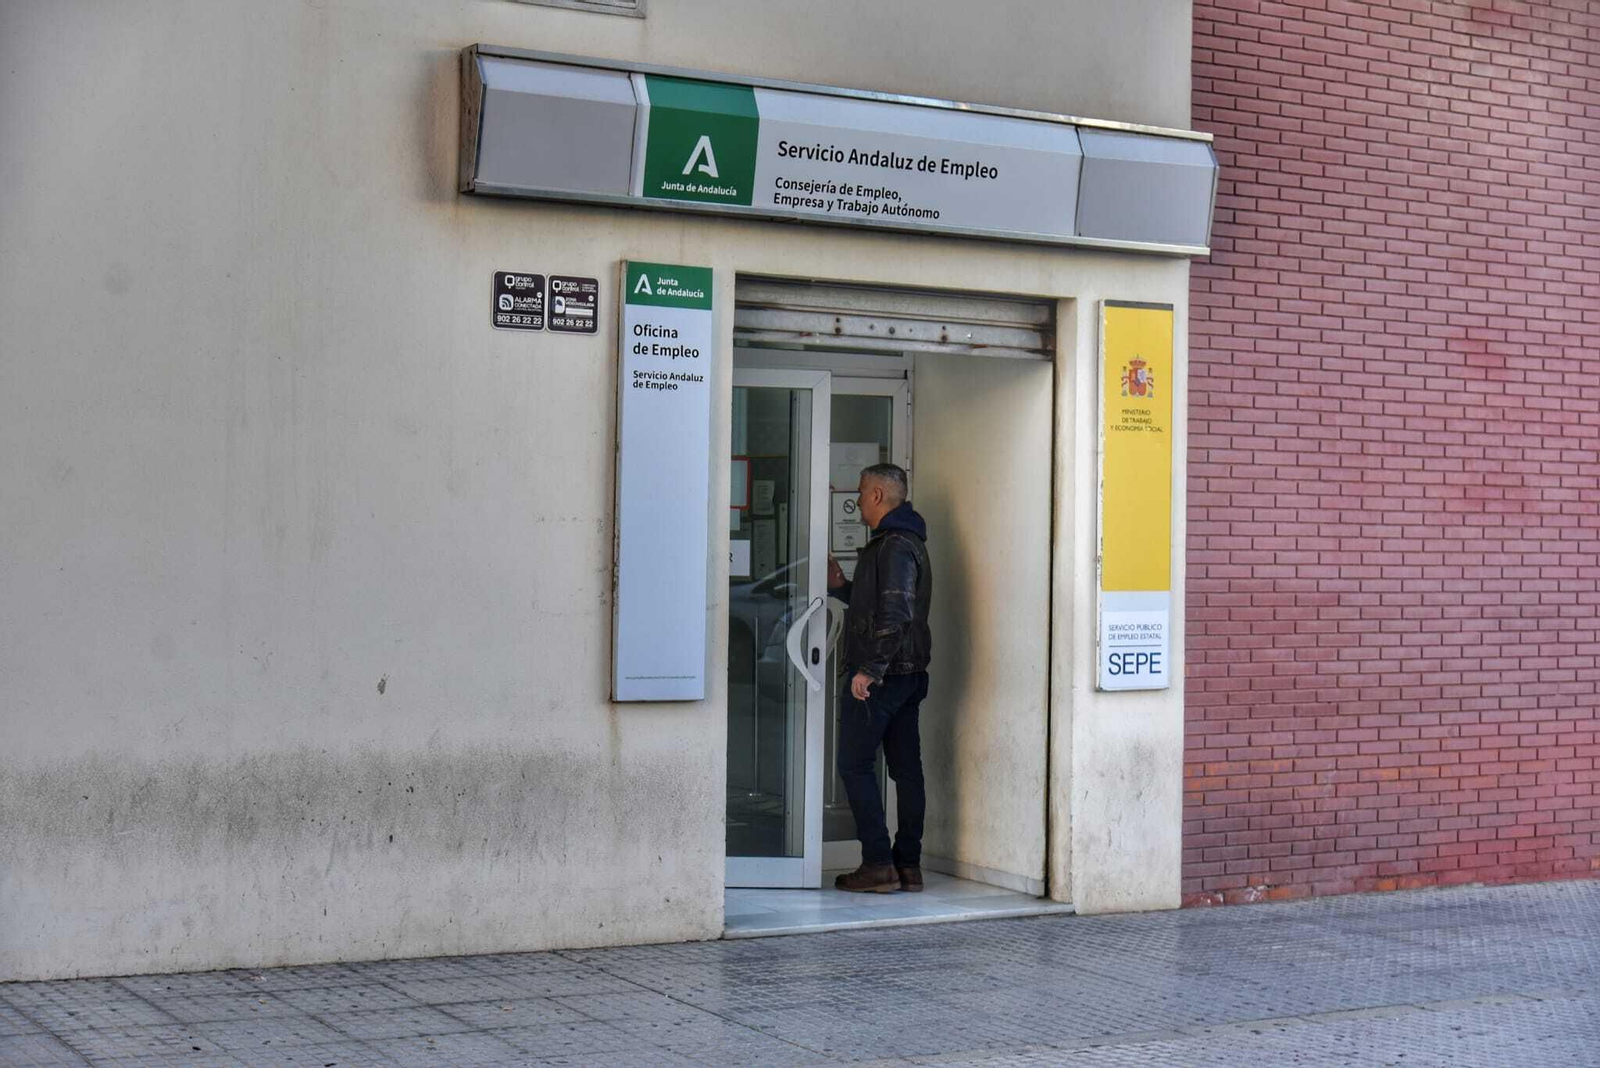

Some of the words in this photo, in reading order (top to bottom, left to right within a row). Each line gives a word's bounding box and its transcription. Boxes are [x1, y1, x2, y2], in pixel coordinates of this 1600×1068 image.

[777, 140, 844, 163] Servicio
[847, 148, 914, 171] Andaluz
[917, 155, 937, 173] de
[940, 158, 999, 181] Empleo
[661, 181, 685, 191] Junta
[686, 183, 697, 192] de
[697, 184, 738, 196] Andalucía
[775, 177, 837, 195] Consejería
[839, 183, 854, 196] de
[856, 185, 902, 203] Empleo,
[773, 192, 825, 209] Empresa
[827, 200, 834, 212] y
[837, 198, 879, 216] Trabajo
[881, 202, 940, 220] Autónomo
[657, 277, 679, 287] Junta
[514, 296, 542, 304] ALARMA
[656, 287, 667, 296] de
[667, 288, 705, 299] Andalucía
[497, 315, 511, 323] 902
[533, 317, 543, 325] 22
[552, 318, 565, 326] 902
[585, 320, 594, 328] 22
[633, 324, 678, 339] Oficina
[633, 342, 649, 355] de
[652, 344, 700, 360] Empleo
[633, 370, 668, 381] Servicio
[669, 372, 704, 383] Andaluz
[633, 380, 644, 389] de
[645, 380, 679, 392] Empleo
[1108, 652, 1162, 676] SEPE
